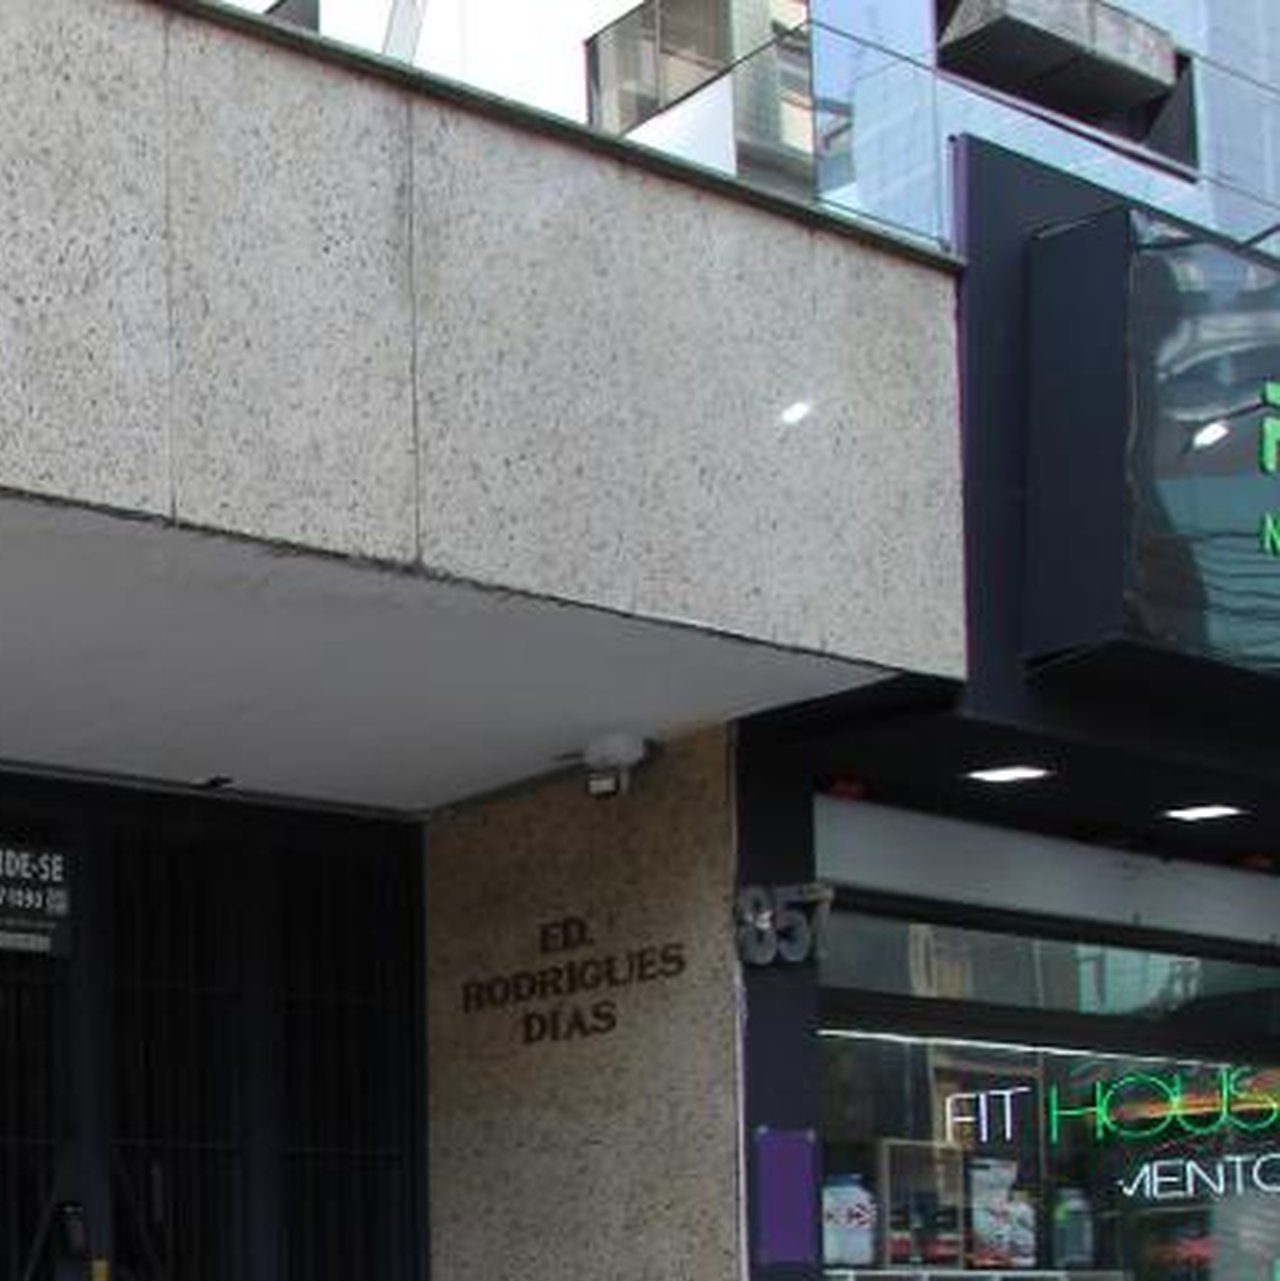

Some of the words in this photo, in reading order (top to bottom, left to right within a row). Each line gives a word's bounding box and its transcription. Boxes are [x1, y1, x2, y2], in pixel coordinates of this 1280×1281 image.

[540, 917, 595, 953] ED.
[463, 943, 687, 1014] RODRIGUES
[523, 1000, 617, 1044] DIAS
[944, 1086, 1030, 1143] FIT
